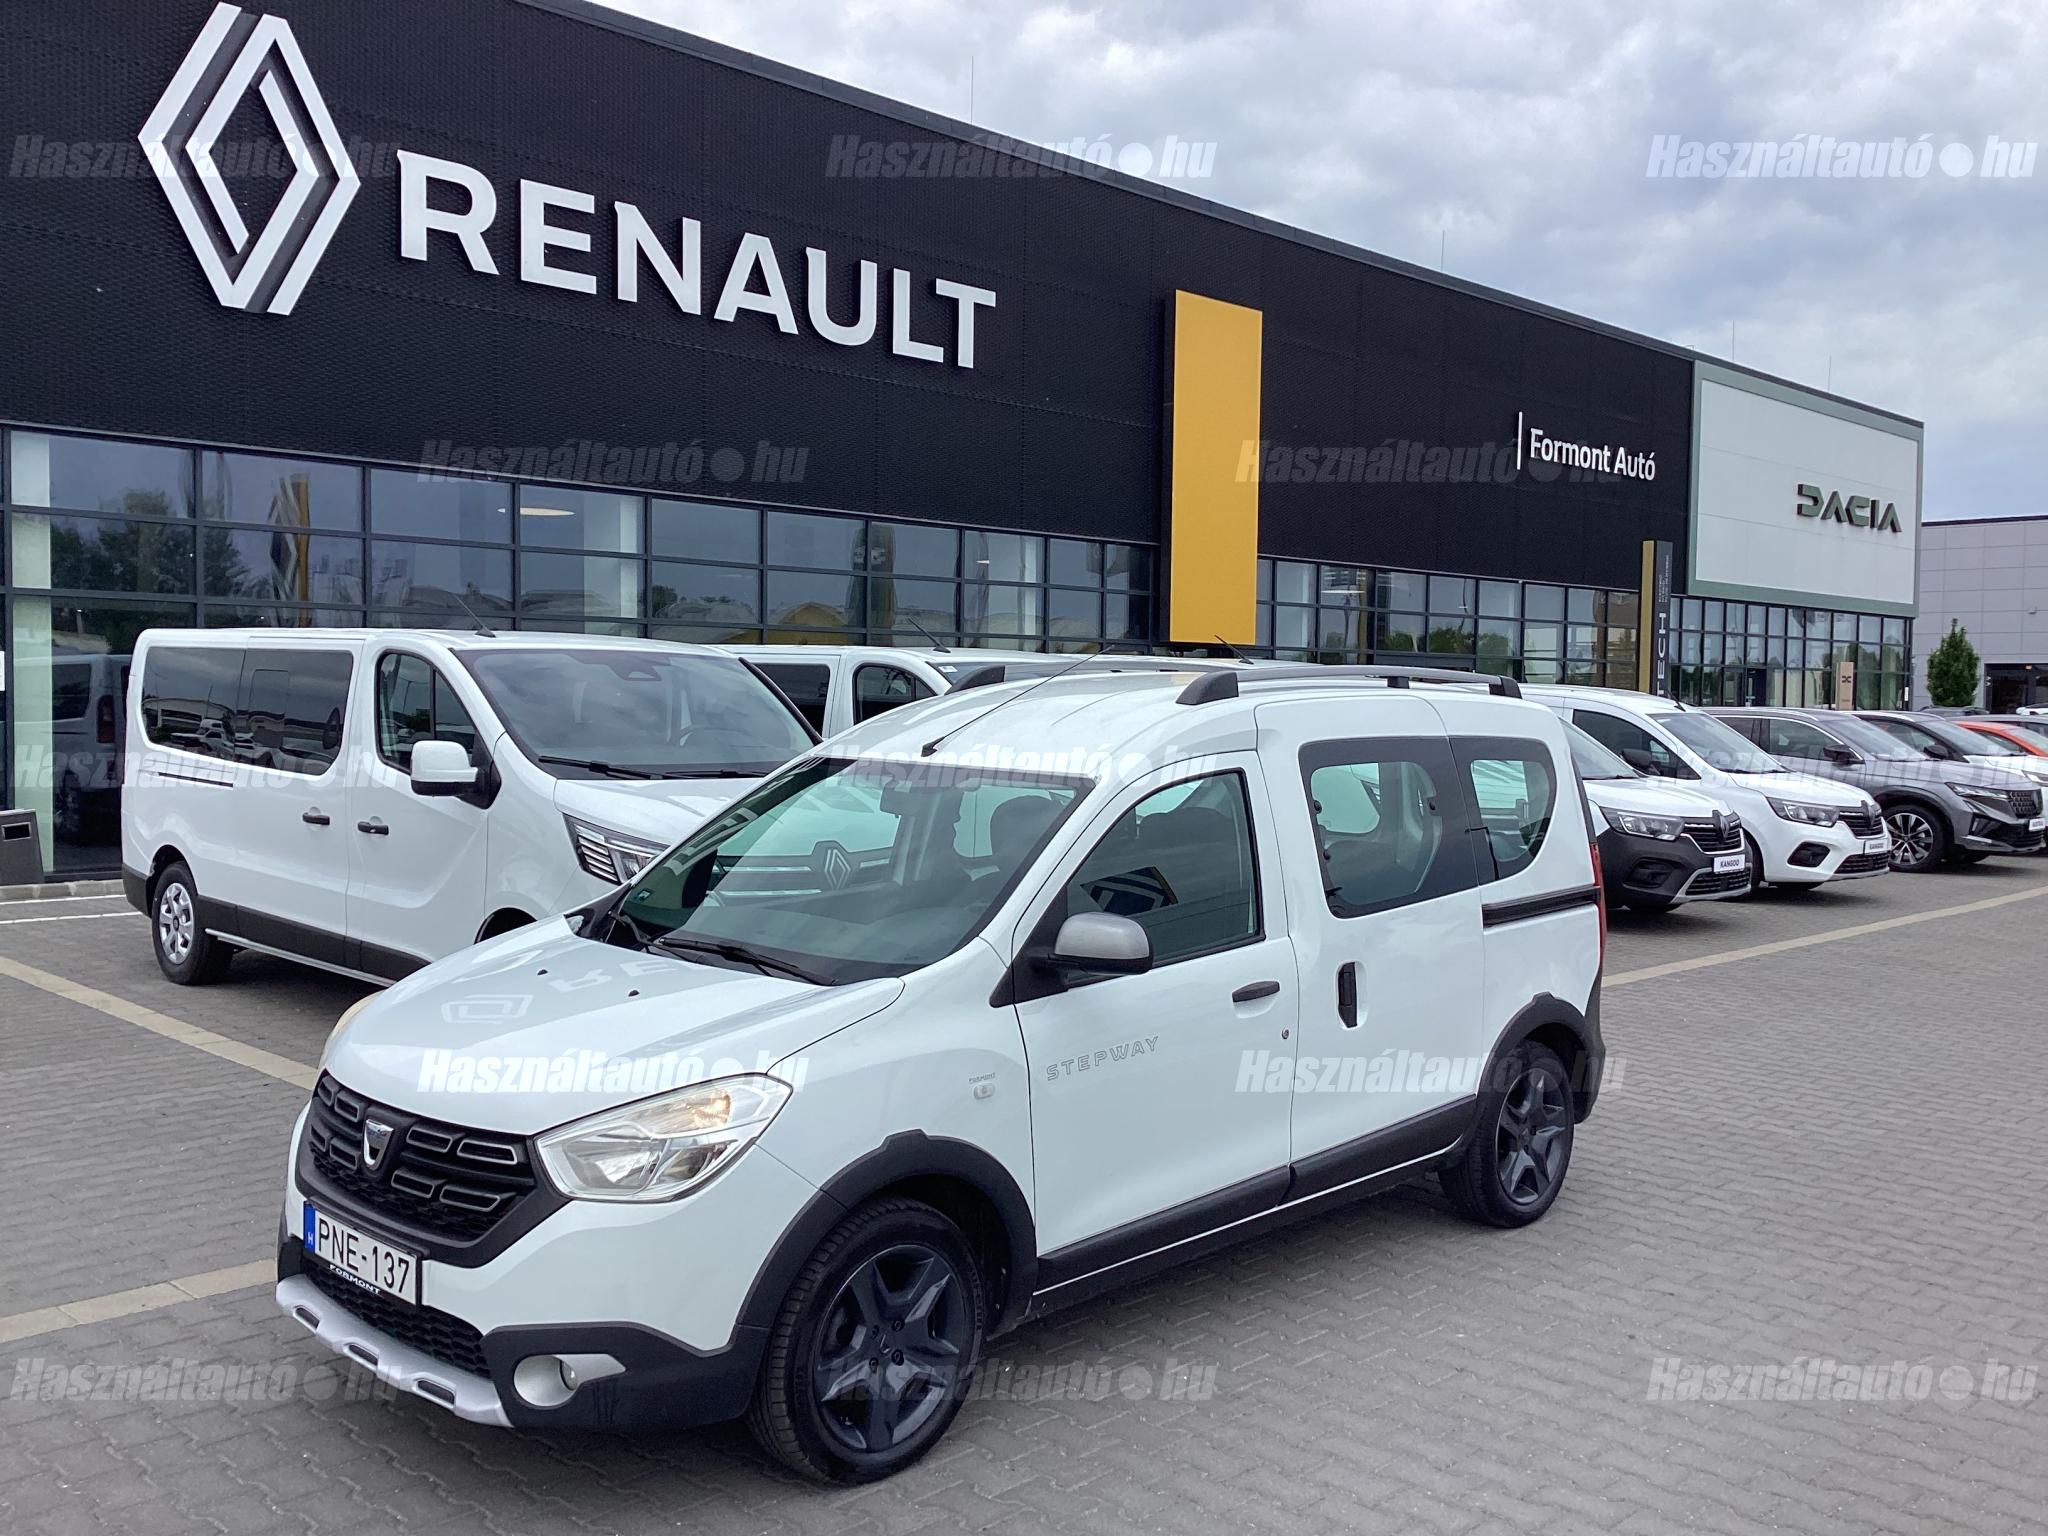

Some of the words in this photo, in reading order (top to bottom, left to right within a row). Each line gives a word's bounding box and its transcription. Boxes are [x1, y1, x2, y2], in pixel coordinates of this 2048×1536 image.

[397, 149, 996, 368] RENAULT
[1530, 427, 1611, 473] Formont
[1613, 445, 1656, 481] Autó
[1796, 482, 1902, 533] DACIA
[1046, 1036, 1159, 1081] STEPWAY
[307, 1232, 313, 1245] H
[318, 1217, 410, 1294] PNE-137
[329, 1264, 382, 1295] FORMONT
